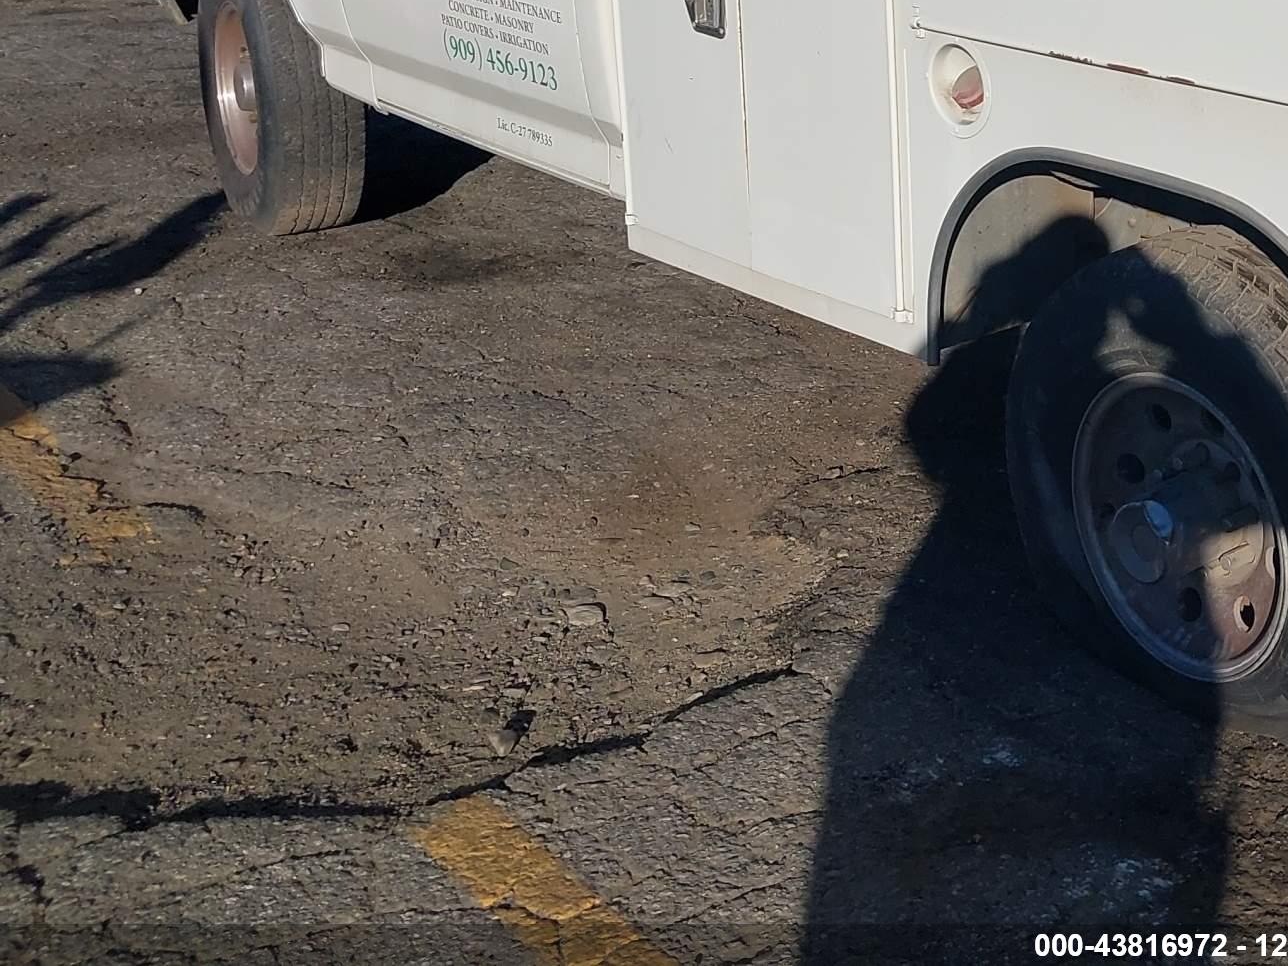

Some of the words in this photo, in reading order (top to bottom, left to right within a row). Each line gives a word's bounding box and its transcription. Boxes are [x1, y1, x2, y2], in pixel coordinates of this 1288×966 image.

[441, 13, 463, 31] PATIO
[463, 20, 494, 39] COVERS
[499, 31, 550, 55] IRRIGATION
[448, 0, 490, 22] CONCRETE
[494, 12, 534, 34] MASONRY
[443, 27, 483, 71] (909)
[486, 47, 558, 91] 456-9123
